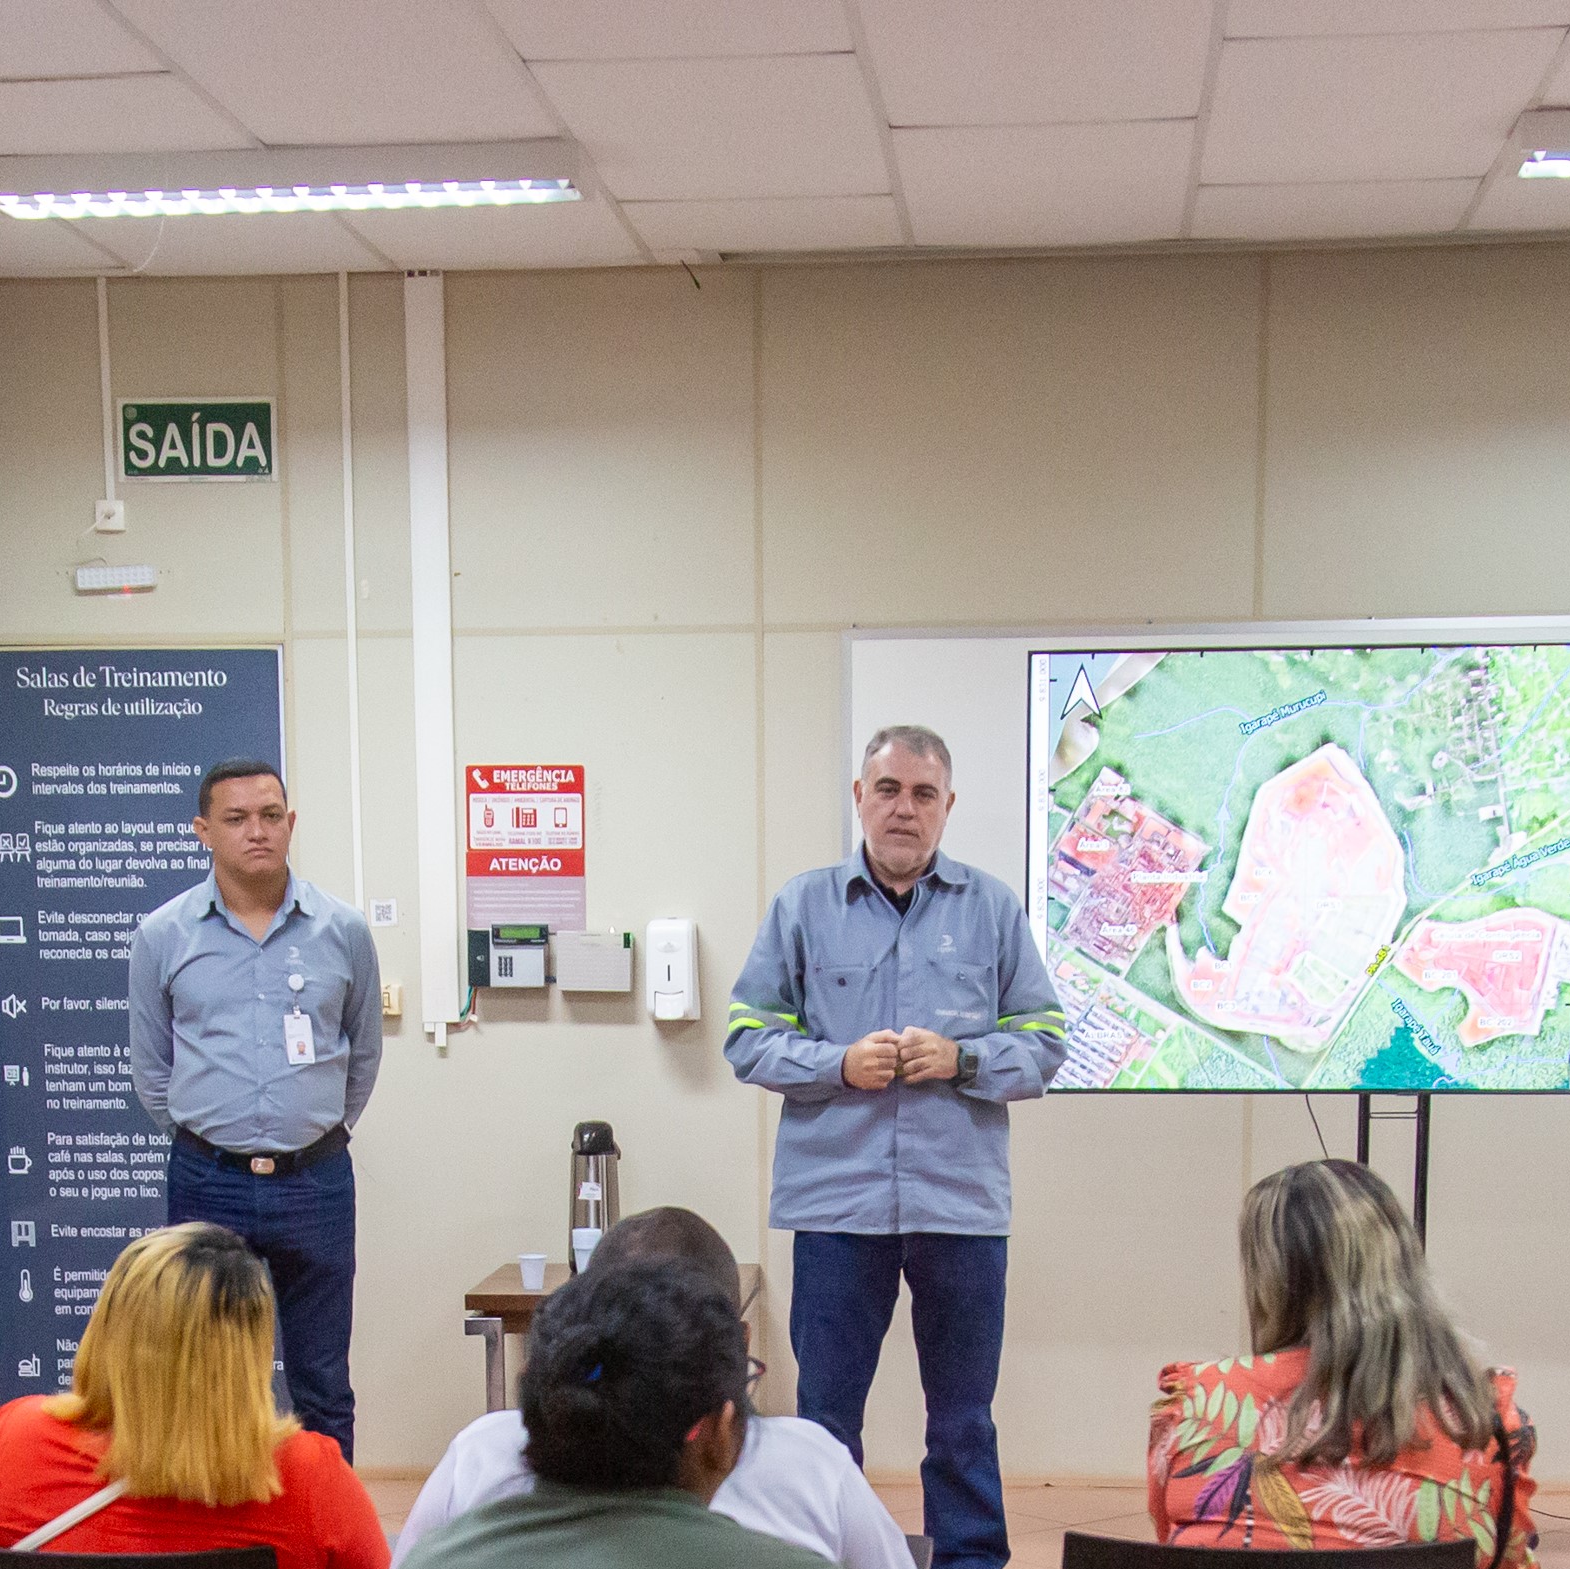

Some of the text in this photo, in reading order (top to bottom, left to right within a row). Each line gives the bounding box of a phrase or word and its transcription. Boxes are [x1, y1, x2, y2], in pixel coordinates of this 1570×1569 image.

[129, 412, 267, 468] SAÍDA
[16, 666, 227, 688] Salas de Treinamento
[43, 698, 202, 720] Regras de utilização
[1239, 690, 1327, 735] Igarapé Murucupi
[31, 762, 201, 778] Respeite os horários de início e
[493, 766, 575, 783] EMERGÊNCIA
[32, 781, 183, 795] intervalos dos treinamentos.
[505, 782, 558, 790] TELEFONES
[35, 822, 65, 837] Fique
[69, 822, 102, 834] atento
[105, 825, 118, 834] ao
[122, 822, 154, 837] layout
[157, 824, 174, 834] em
[35, 840, 65, 852] estão
[68, 839, 137, 855] organizadas,
[141, 842, 153, 852] se
[157, 839, 199, 854] precisar
[36, 857, 209, 872] alguma do lugar devolva ao final
[489, 855, 561, 873] ATENÇÃO
[1471, 859, 1512, 886] Igarapé
[1512, 853, 1540, 869] Água
[37, 875, 147, 889] treinamento/reunião.
[38, 911, 64, 923] Evite
[68, 911, 133, 923] desconectar
[39, 929, 82, 943] tomada,
[85, 932, 111, 942] caso
[39, 948, 92, 960] reconecte
[96, 949, 108, 960] os
[42, 997, 60, 1010] Por
[63, 998, 93, 1011] favor,
[1391, 998, 1423, 1034] Igarapé
[44, 1044, 74, 1060] Fique
[78, 1045, 110, 1057] atento
[114, 1045, 121, 1057] à
[45, 1062, 90, 1076] instrutor,
[94, 1062, 114, 1075] isso
[46, 1080, 85, 1092] tenham
[89, 1082, 105, 1092] um
[109, 1080, 131, 1092] bom
[47, 1097, 129, 1109] no treinamento.
[48, 1133, 72, 1145] Para
[76, 1133, 129, 1148] satisfação
[132, 1133, 145, 1145] de
[48, 1150, 74, 1163] café
[78, 1153, 96, 1162] nas
[100, 1151, 127, 1164] salas,
[130, 1151, 164, 1164] porém
[49, 1168, 167, 1182] após o uso dos copos,
[50, 1185, 161, 1200] o seu e jogue no lixo.
[51, 1225, 77, 1237] Evite
[81, 1226, 126, 1237] encostar
[129, 1228, 142, 1237] as
[54, 1266, 61, 1281] É
[55, 1305, 71, 1315] em
[57, 1339, 78, 1351] Não
